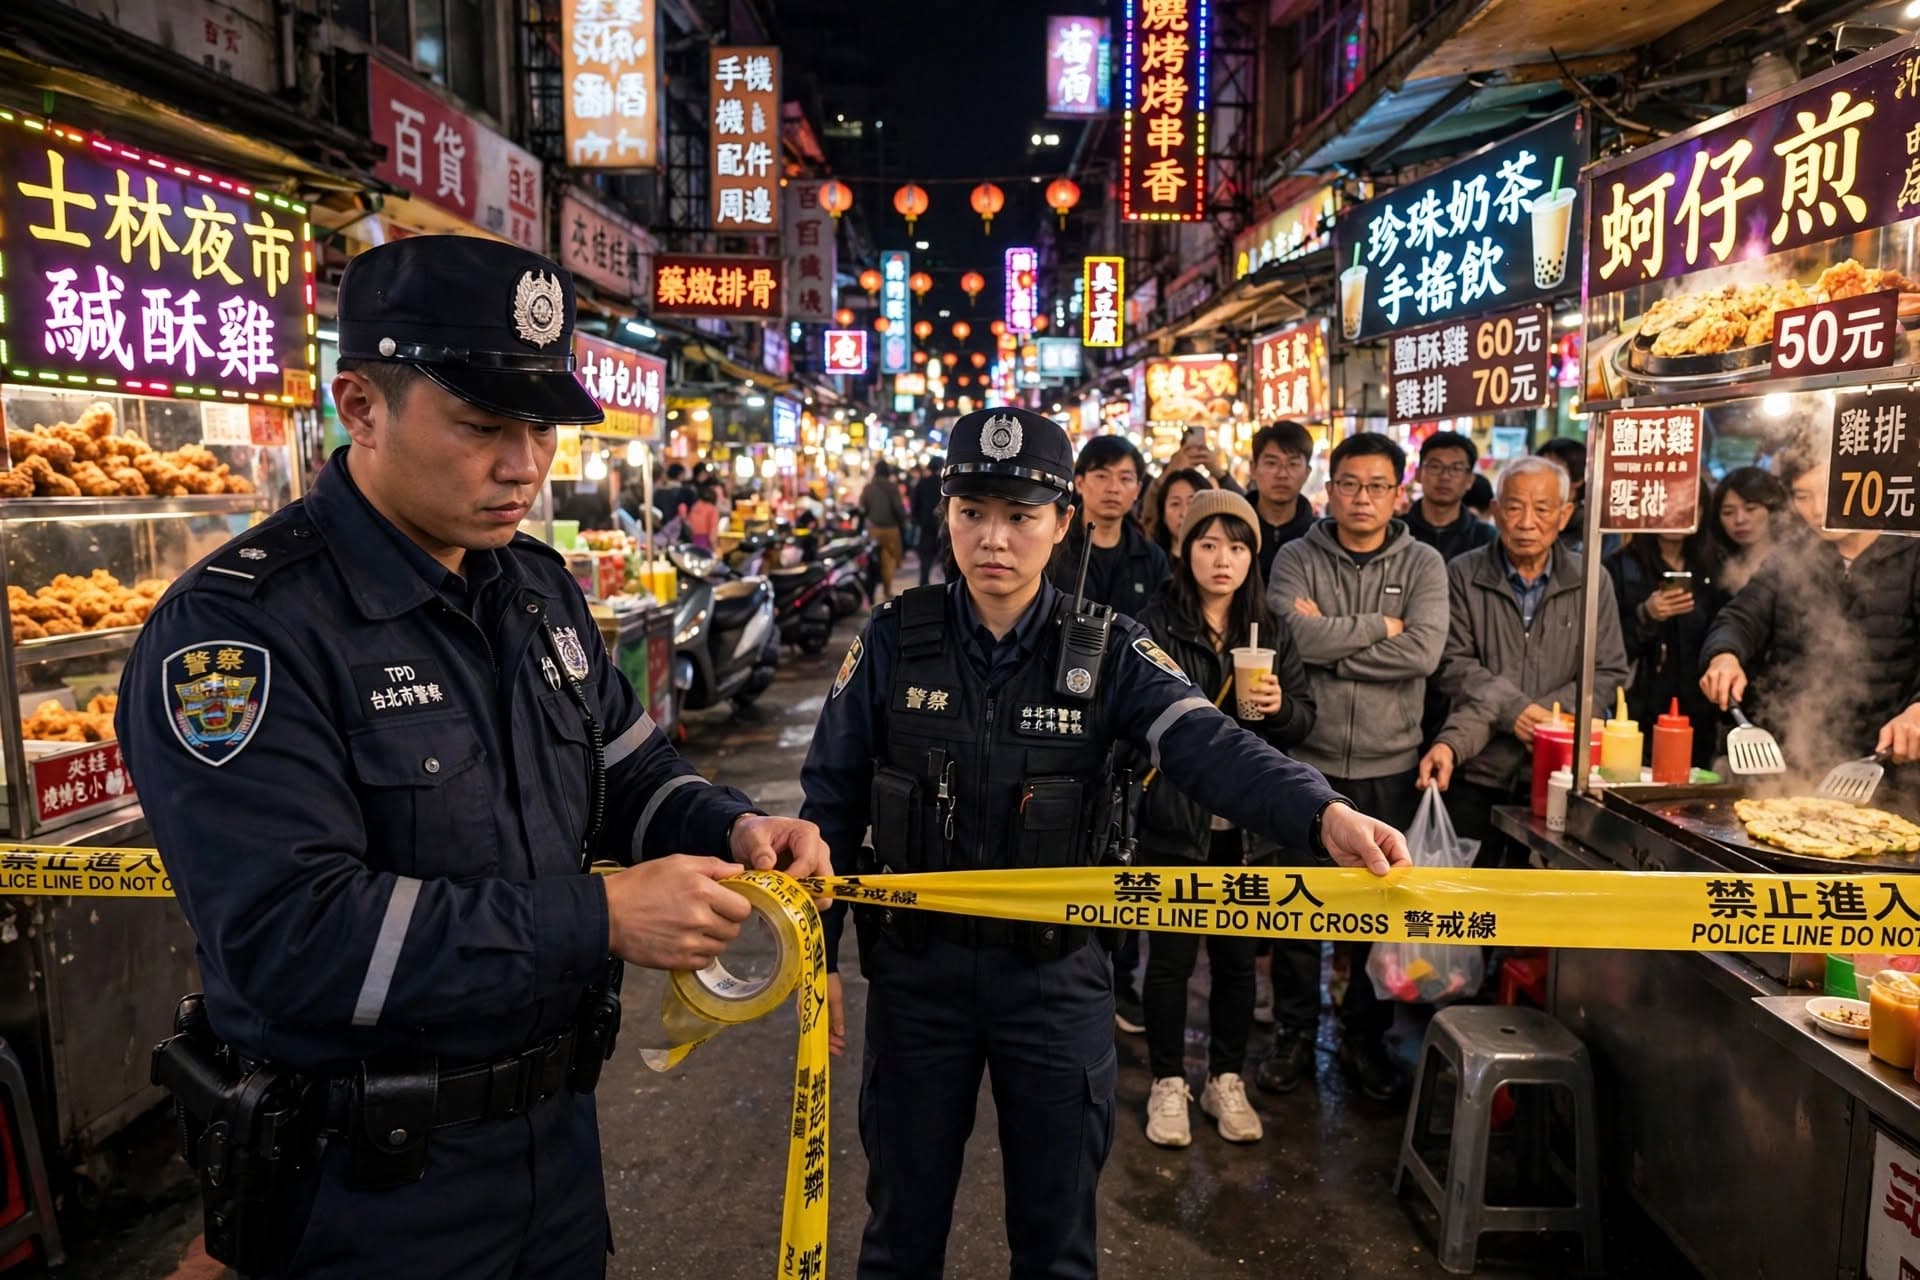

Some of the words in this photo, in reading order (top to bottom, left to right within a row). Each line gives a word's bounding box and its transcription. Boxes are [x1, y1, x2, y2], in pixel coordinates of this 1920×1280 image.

[715, 55, 773, 92] 手機
[390, 99, 466, 206] 百貨
[716, 142, 773, 177] 配件
[717, 187, 772, 223] 周邊
[1599, 91, 1875, 280] 蚵仔煎
[17, 150, 294, 297] 士林夜市
[1367, 150, 1543, 267] 珍珠奶茶
[657, 265, 776, 309] 藥燉排骨
[1377, 236, 1507, 325] 手搖飲
[1393, 325, 1469, 375] 鹽酥雞
[1477, 315, 1541, 360] 60元
[1777, 307, 1885, 369] 50元
[1396, 374, 1447, 418] 雞排
[1472, 363, 1538, 407] 70元
[1611, 416, 1694, 456] 鹽酥雞
[1839, 405, 1907, 456] 雞排
[1841, 470, 1915, 517] 70元
[183, 647, 245, 676] 警察
[384, 665, 415, 682] TPD
[370, 682, 443, 710] 台北市警察
[905, 686, 949, 711] 警察
[2, 848, 161, 873] 禁止進入
[43, 875, 82, 889] LINE
[89, 876, 114, 890] DO
[120, 877, 156, 890] NOT
[1114, 871, 1325, 908] 禁止進入
[1706, 879, 1920, 921] 禁止進入
[1065, 904, 1149, 926] POLICE
[1157, 908, 1208, 928] LINE
[1216, 910, 1248, 930] DO
[1256, 911, 1303, 932] NOT
[1310, 912, 1389, 934] CROSS
[1403, 910, 1497, 939] 警戒線
[1691, 923, 1775, 945] POLICE
[1782, 925, 1834, 945] LINE
[1840, 926, 1874, 947] DO
[802, 971, 814, 1035] CROSS
